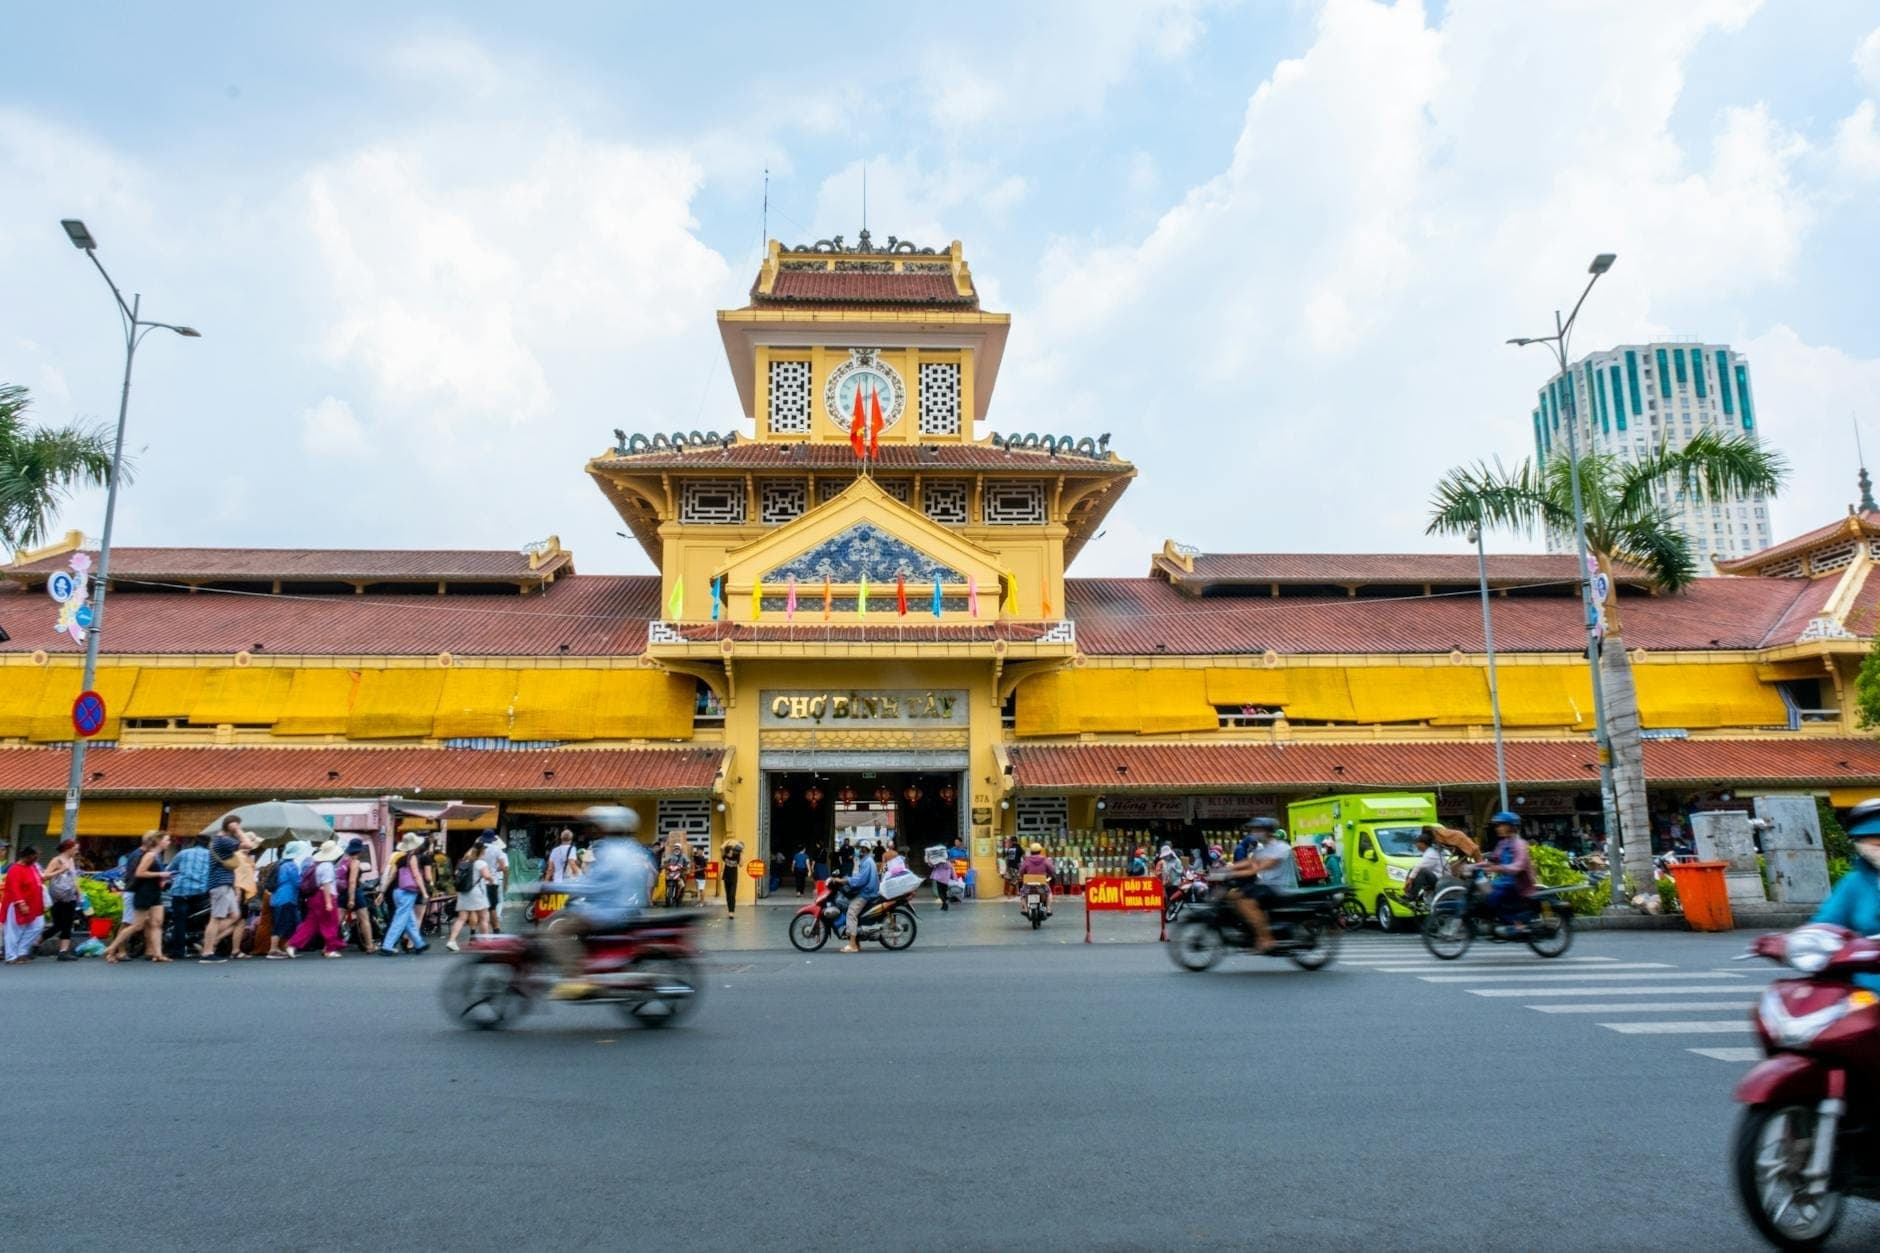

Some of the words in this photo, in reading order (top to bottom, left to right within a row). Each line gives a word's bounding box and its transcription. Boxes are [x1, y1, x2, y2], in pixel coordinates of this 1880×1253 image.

[771, 693, 827, 724] CHỢ
[907, 691, 956, 719] TÂY
[1089, 881, 1119, 904] CẤM
[1142, 880, 1153, 891] XE
